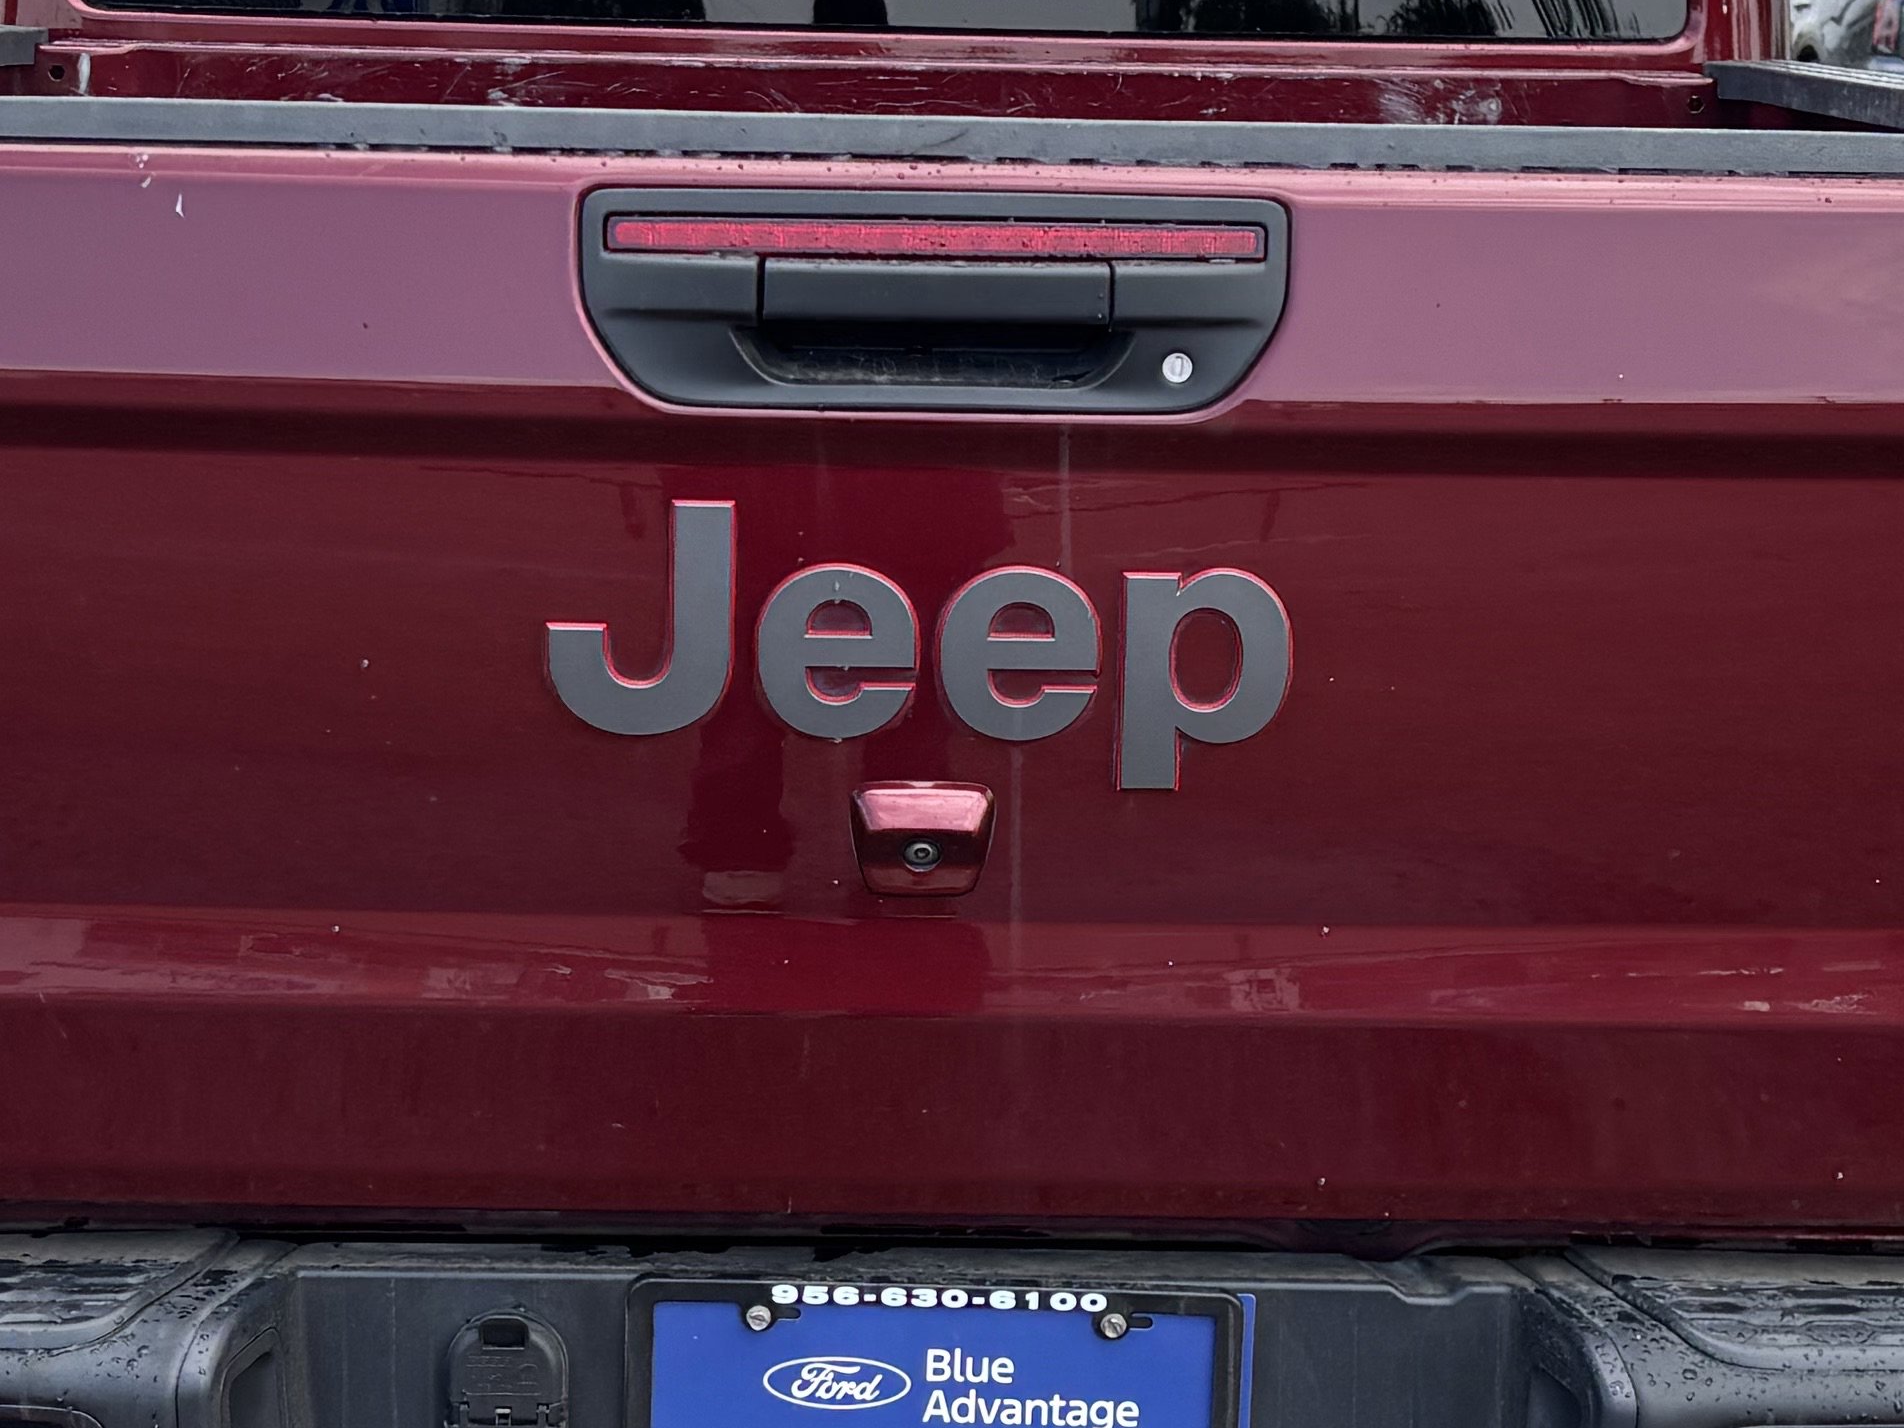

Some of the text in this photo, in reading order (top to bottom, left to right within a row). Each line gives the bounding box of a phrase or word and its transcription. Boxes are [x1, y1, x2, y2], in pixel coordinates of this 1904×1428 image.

[544, 499, 1294, 792] Jeep
[771, 1283, 1108, 1313] 956-630-6100
[790, 1361, 883, 1401] Ford
[925, 1348, 1014, 1384] Blue
